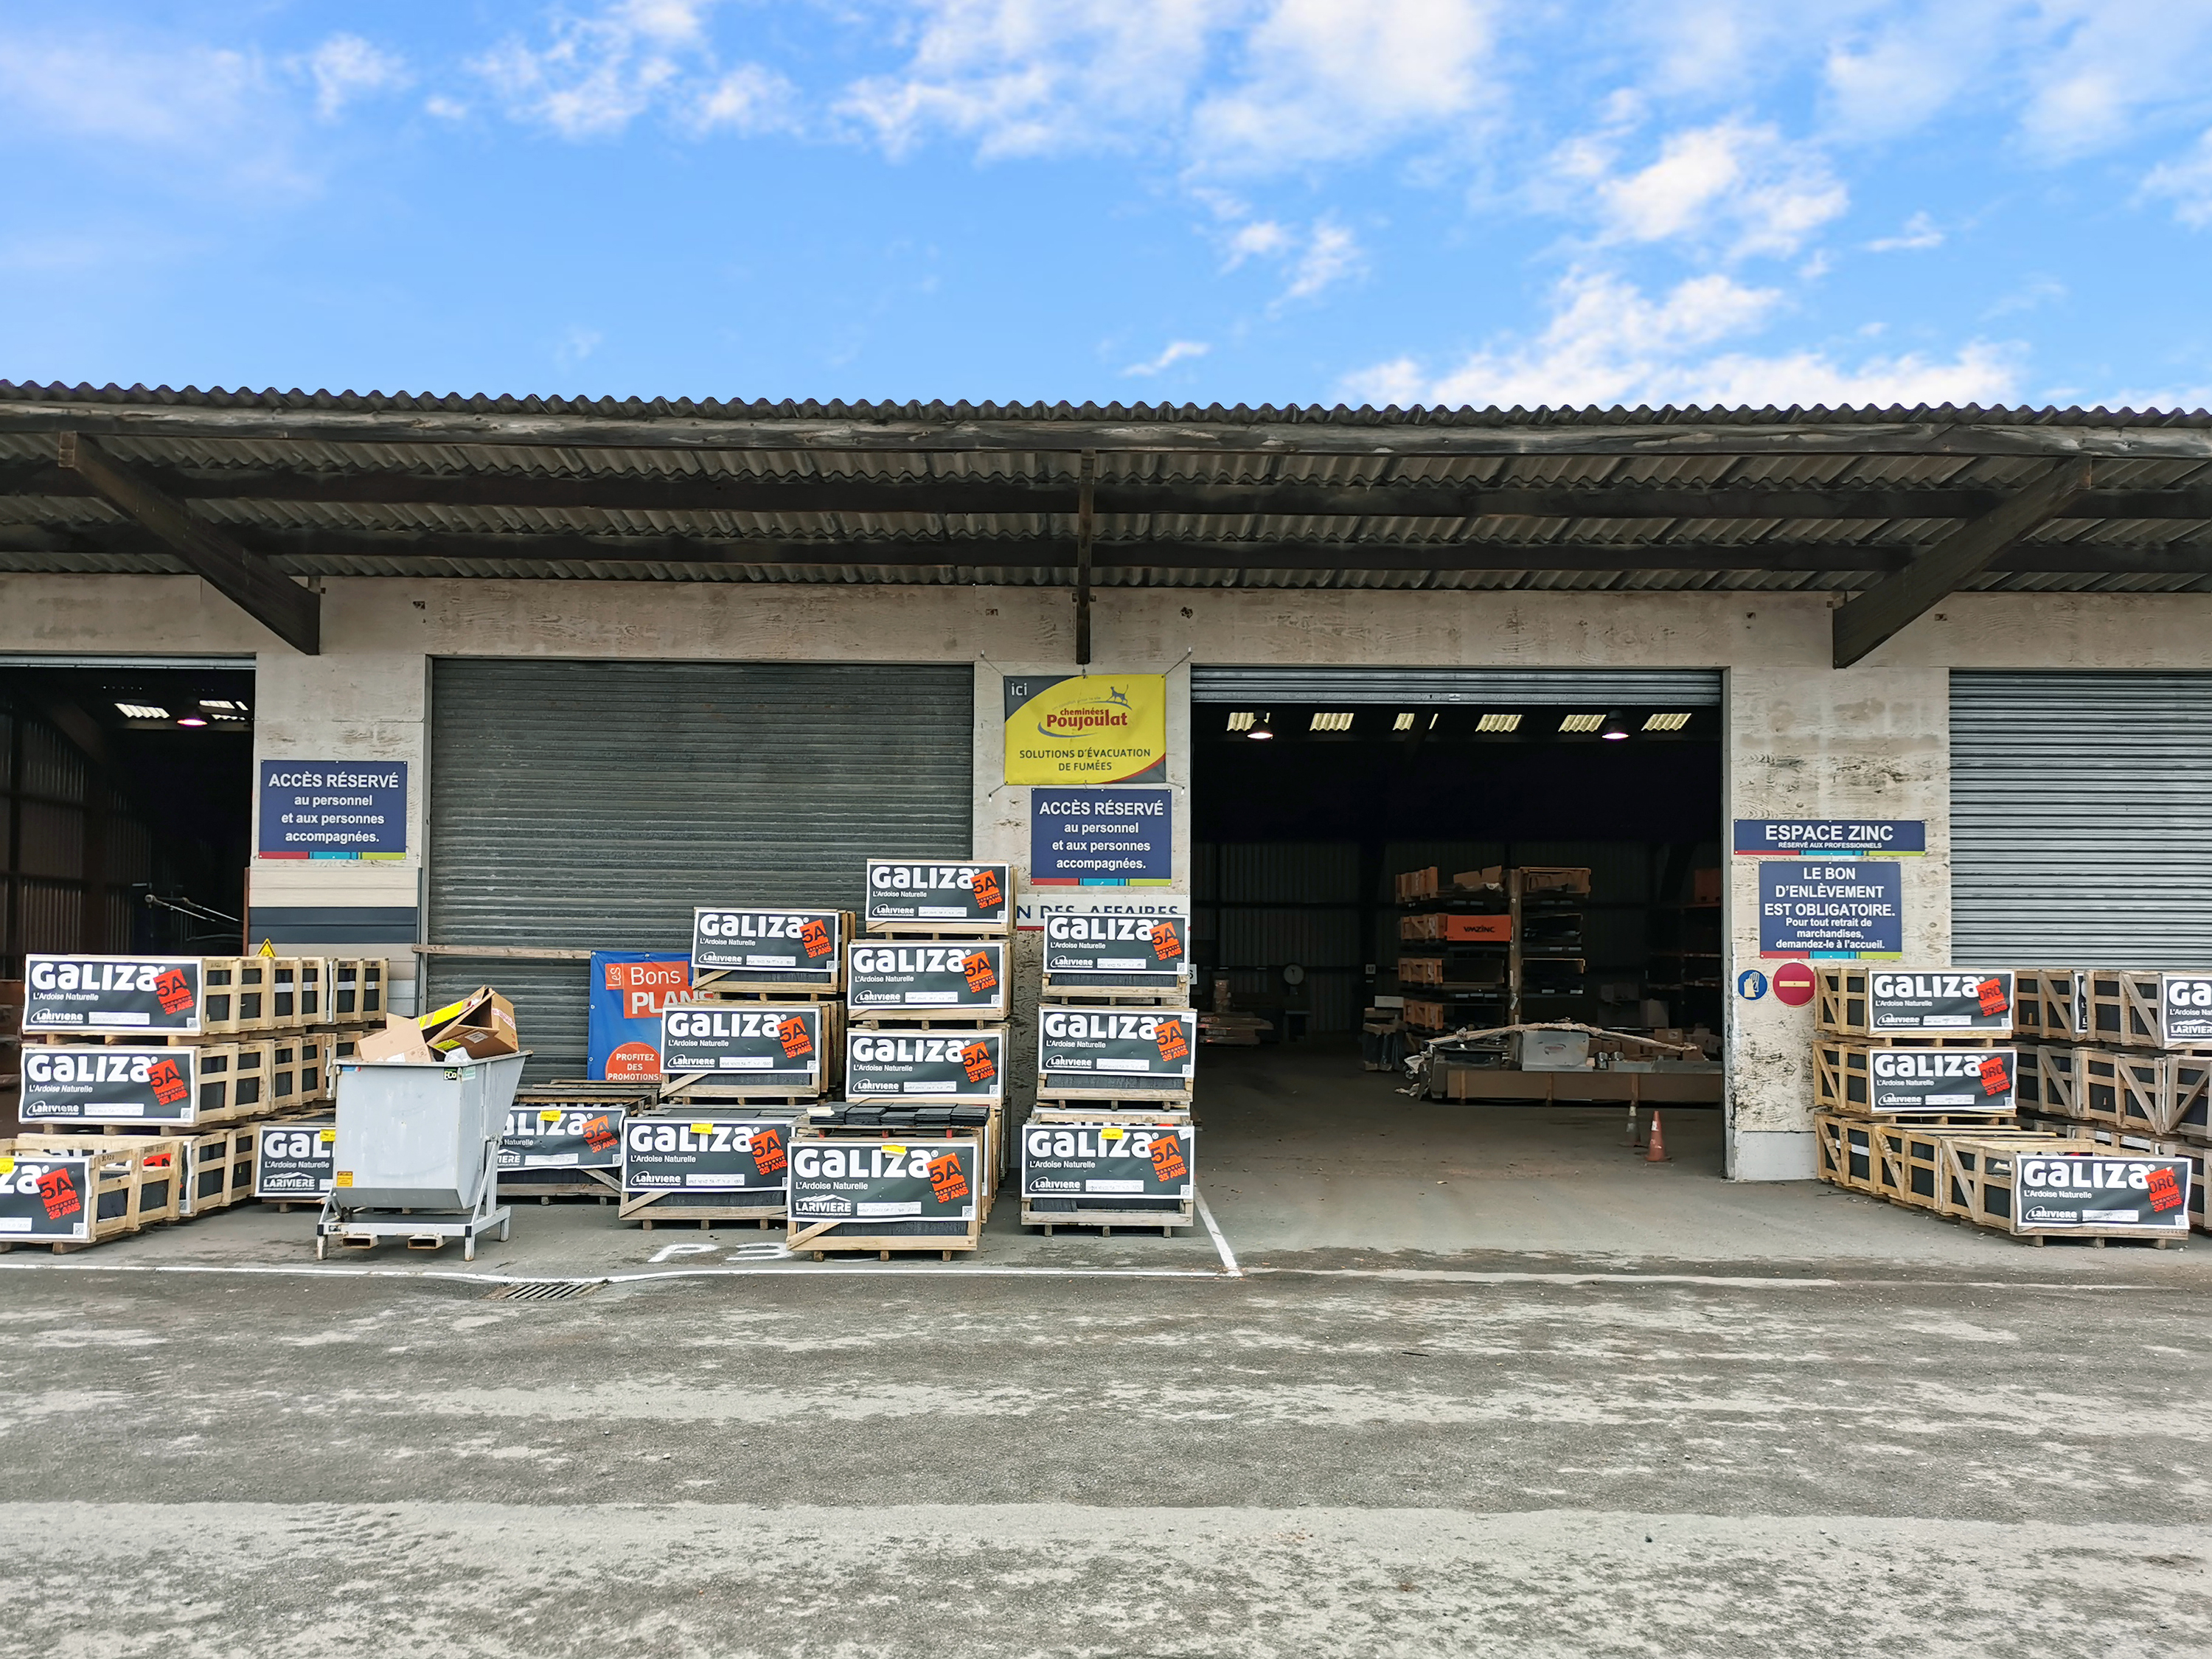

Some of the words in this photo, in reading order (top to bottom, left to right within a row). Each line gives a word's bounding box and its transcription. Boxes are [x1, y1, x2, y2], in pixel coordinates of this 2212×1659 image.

[1011, 683, 1027, 696] ici
[1060, 708, 1104, 716] cheminées
[1047, 709, 1127, 731] Poujoulat
[1020, 750, 1075, 759] SOLUTIONS
[1059, 762, 1071, 771] DE
[1074, 760, 1112, 771] FUMÉES
[268, 771, 322, 787] ACCÈS
[326, 771, 399, 788] RÉSERVÉ
[294, 796, 310, 805] au
[313, 795, 372, 807] personnel
[1039, 799, 1091, 815] ACCÈS
[1094, 799, 1164, 815] RÉSERVÉ
[281, 813, 293, 824] et
[296, 814, 318, 824] aux
[321, 815, 385, 826] personnes
[1064, 824, 1078, 833] au
[1082, 822, 1138, 835] personnel
[1765, 824, 1843, 841] ESPACE
[1848, 825, 1893, 841] ZINC
[285, 830, 380, 844] accompagnées.
[1052, 840, 1063, 850] et
[1066, 841, 1087, 851] aux
[1090, 842, 1151, 853] personnes
[1056, 858, 1146, 871] accompagnées.
[1804, 867, 1821, 880] LE
[1825, 867, 1856, 880] BON
[973, 876, 997, 894] 5A
[1764, 903, 1792, 916] EST
[1795, 903, 1896, 917] OBLIGATOIRE.
[1786, 918, 1809, 927] Pour
[1810, 918, 1829, 927] tout
[1831, 918, 1859, 927] retrait
[1860, 918, 1872, 927] de
[801, 925, 827, 943] 5A
[1152, 927, 1176, 945] 5A
[1797, 929, 1865, 939] marchandises,
[728, 939, 756, 947] Naturelle
[1776, 939, 1835, 949] demandez-le
[1837, 939, 1843, 949] à
[964, 958, 990, 977] 5A
[630, 967, 681, 985] Bons
[156, 975, 187, 997] 5A
[66, 992, 99, 1001] Naturelle
[780, 1023, 806, 1043] 5A
[1156, 1026, 1183, 1046] 5A
[2170, 1025, 2212, 1034] LARIVIER
[616, 1053, 655, 1061] PROFITEZ
[963, 1048, 990, 1067] 5A
[627, 1063, 643, 1071] DES
[149, 1066, 181, 1087] 5A
[608, 1073, 662, 1081] PROMOTIONS!
[61, 1085, 93, 1093] Naturelle
[582, 1121, 610, 1140] 5A
[752, 1135, 782, 1158] 5A
[664, 1155, 696, 1163] Naturelle
[1150, 1143, 1180, 1164] 5A
[929, 1161, 962, 1184] 5A
[38, 1177, 74, 1200] 5A
[263, 1178, 316, 1188] LARIVIERE
[833, 1182, 869, 1190] Naturelle
[795, 1202, 852, 1212] LARIVIERE
